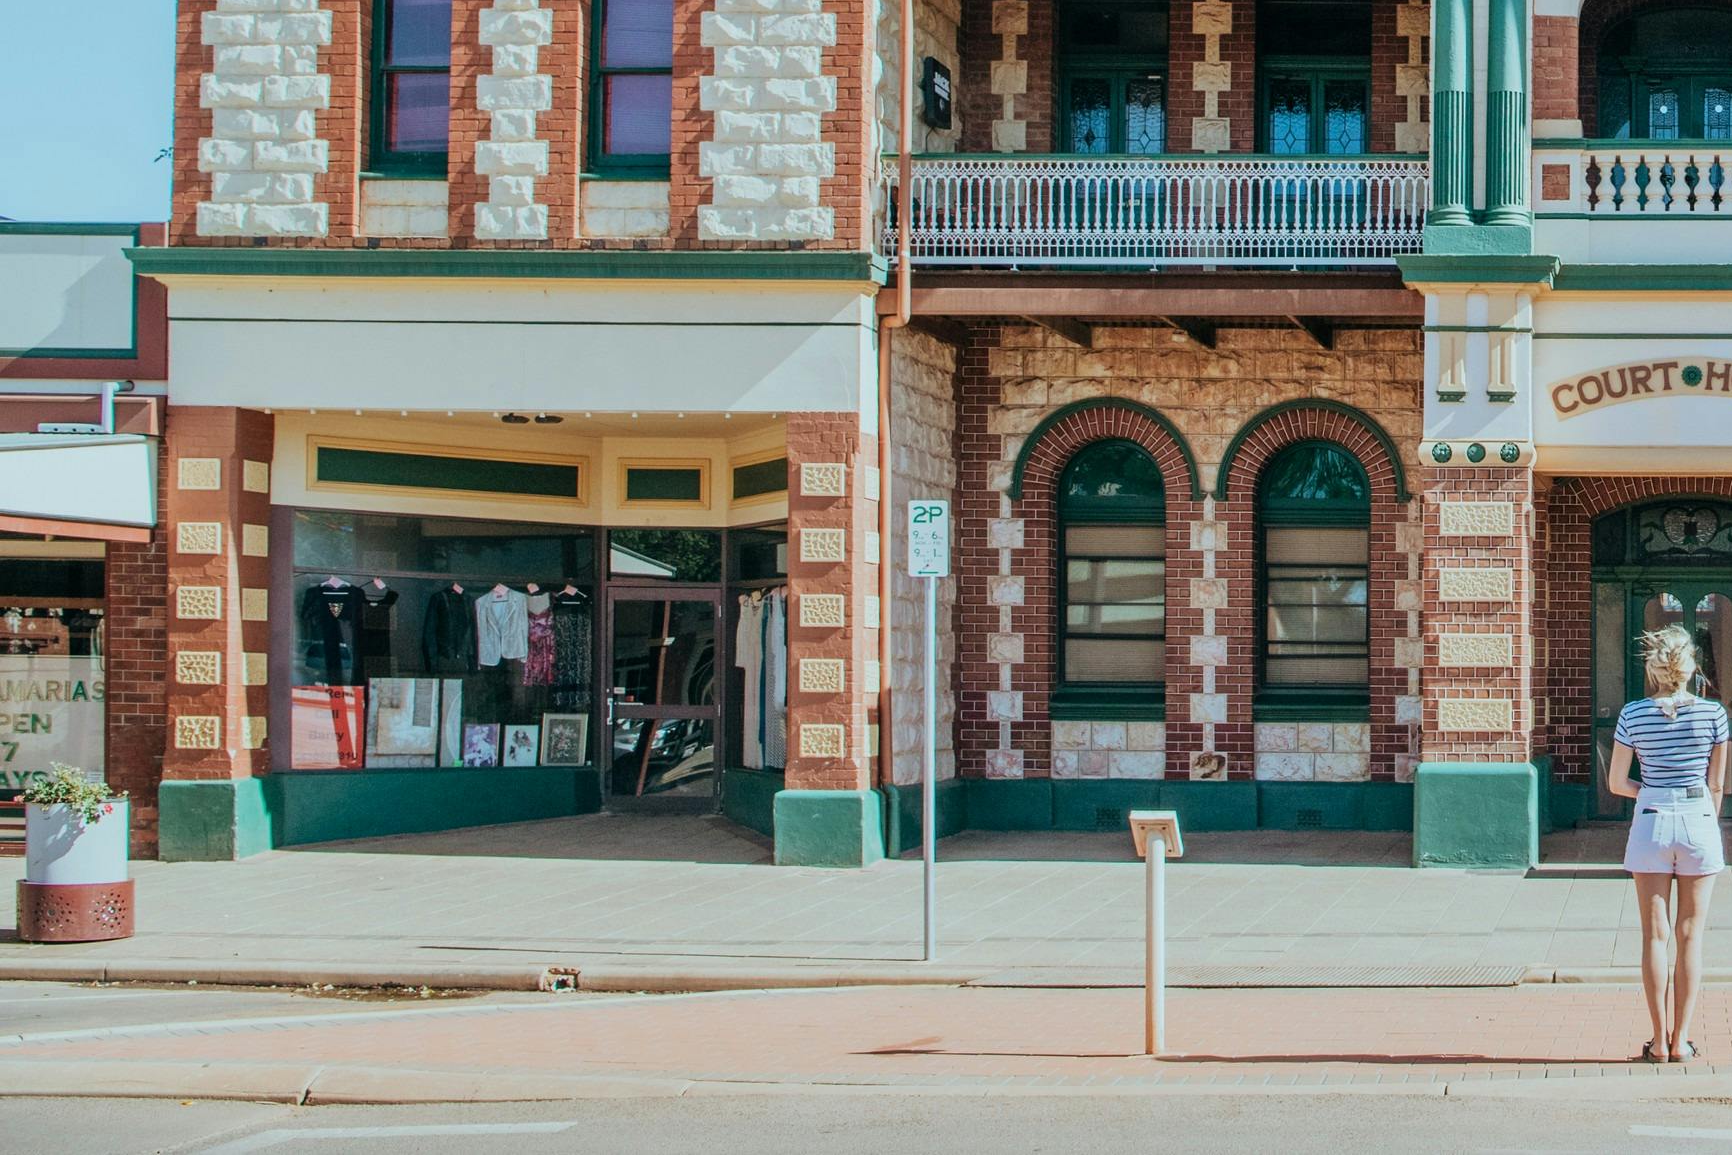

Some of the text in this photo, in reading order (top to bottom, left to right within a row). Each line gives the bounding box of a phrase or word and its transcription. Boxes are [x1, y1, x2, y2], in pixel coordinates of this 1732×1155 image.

[1551, 361, 1679, 414] COURT
[913, 506, 943, 523] 2P
[1, 741, 20, 763] 7
